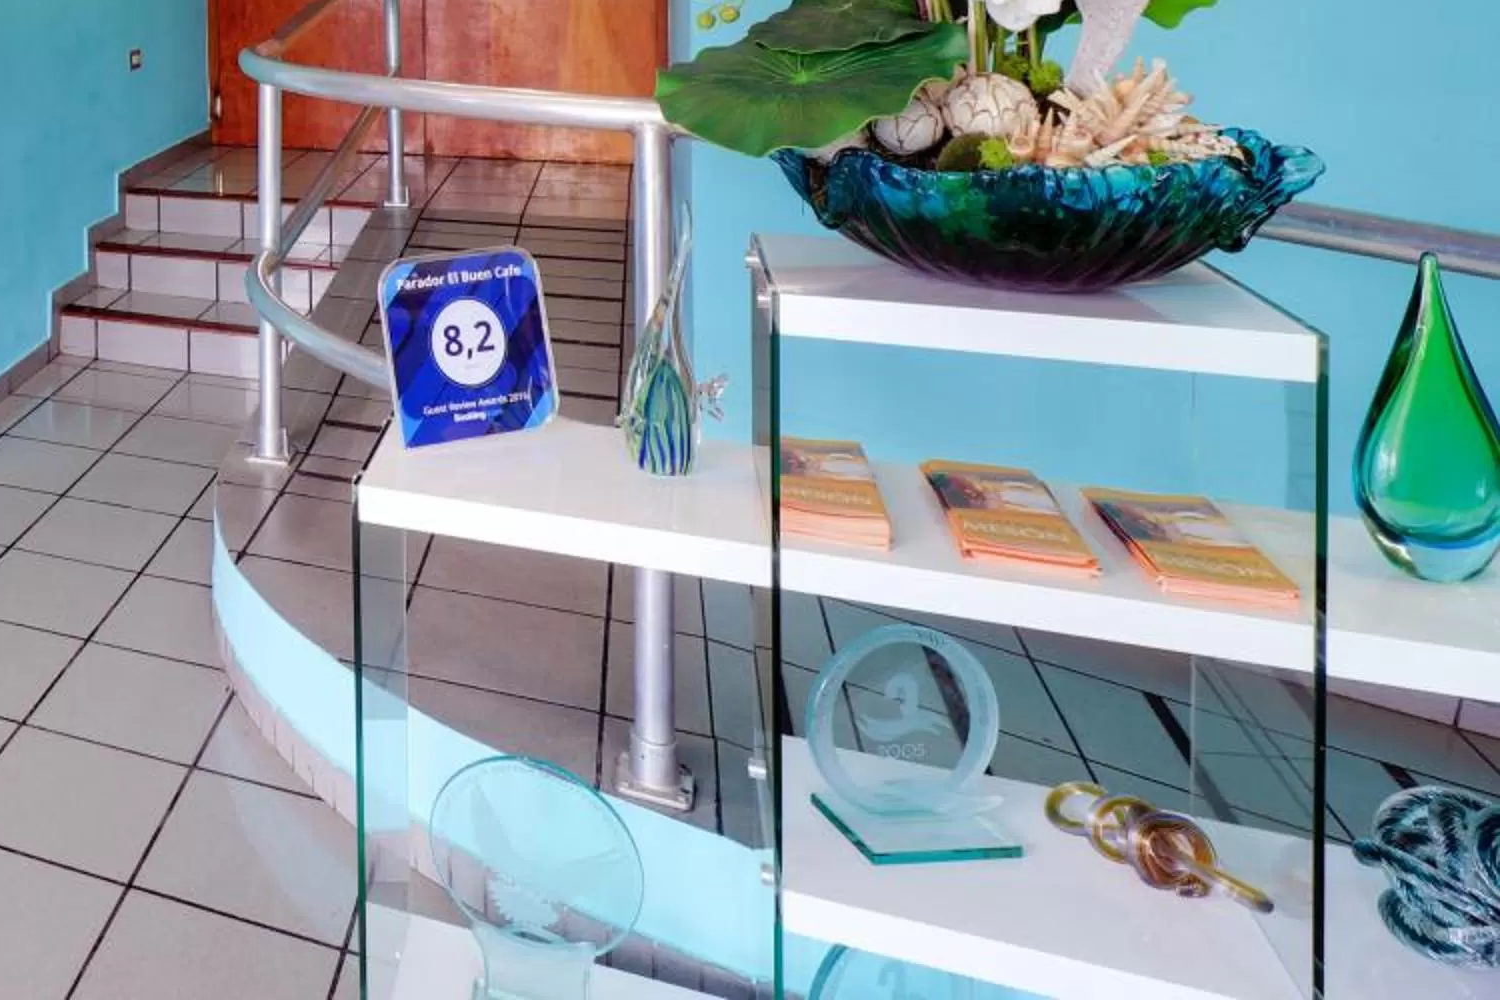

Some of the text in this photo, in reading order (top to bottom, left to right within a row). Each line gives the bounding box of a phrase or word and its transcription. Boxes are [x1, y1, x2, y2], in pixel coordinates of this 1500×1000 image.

[396, 273, 445, 290] Parador
[447, 271, 459, 285] El
[461, 268, 493, 284] Buen
[443, 320, 495, 360] 8,2
[423, 404, 448, 416] Guest
